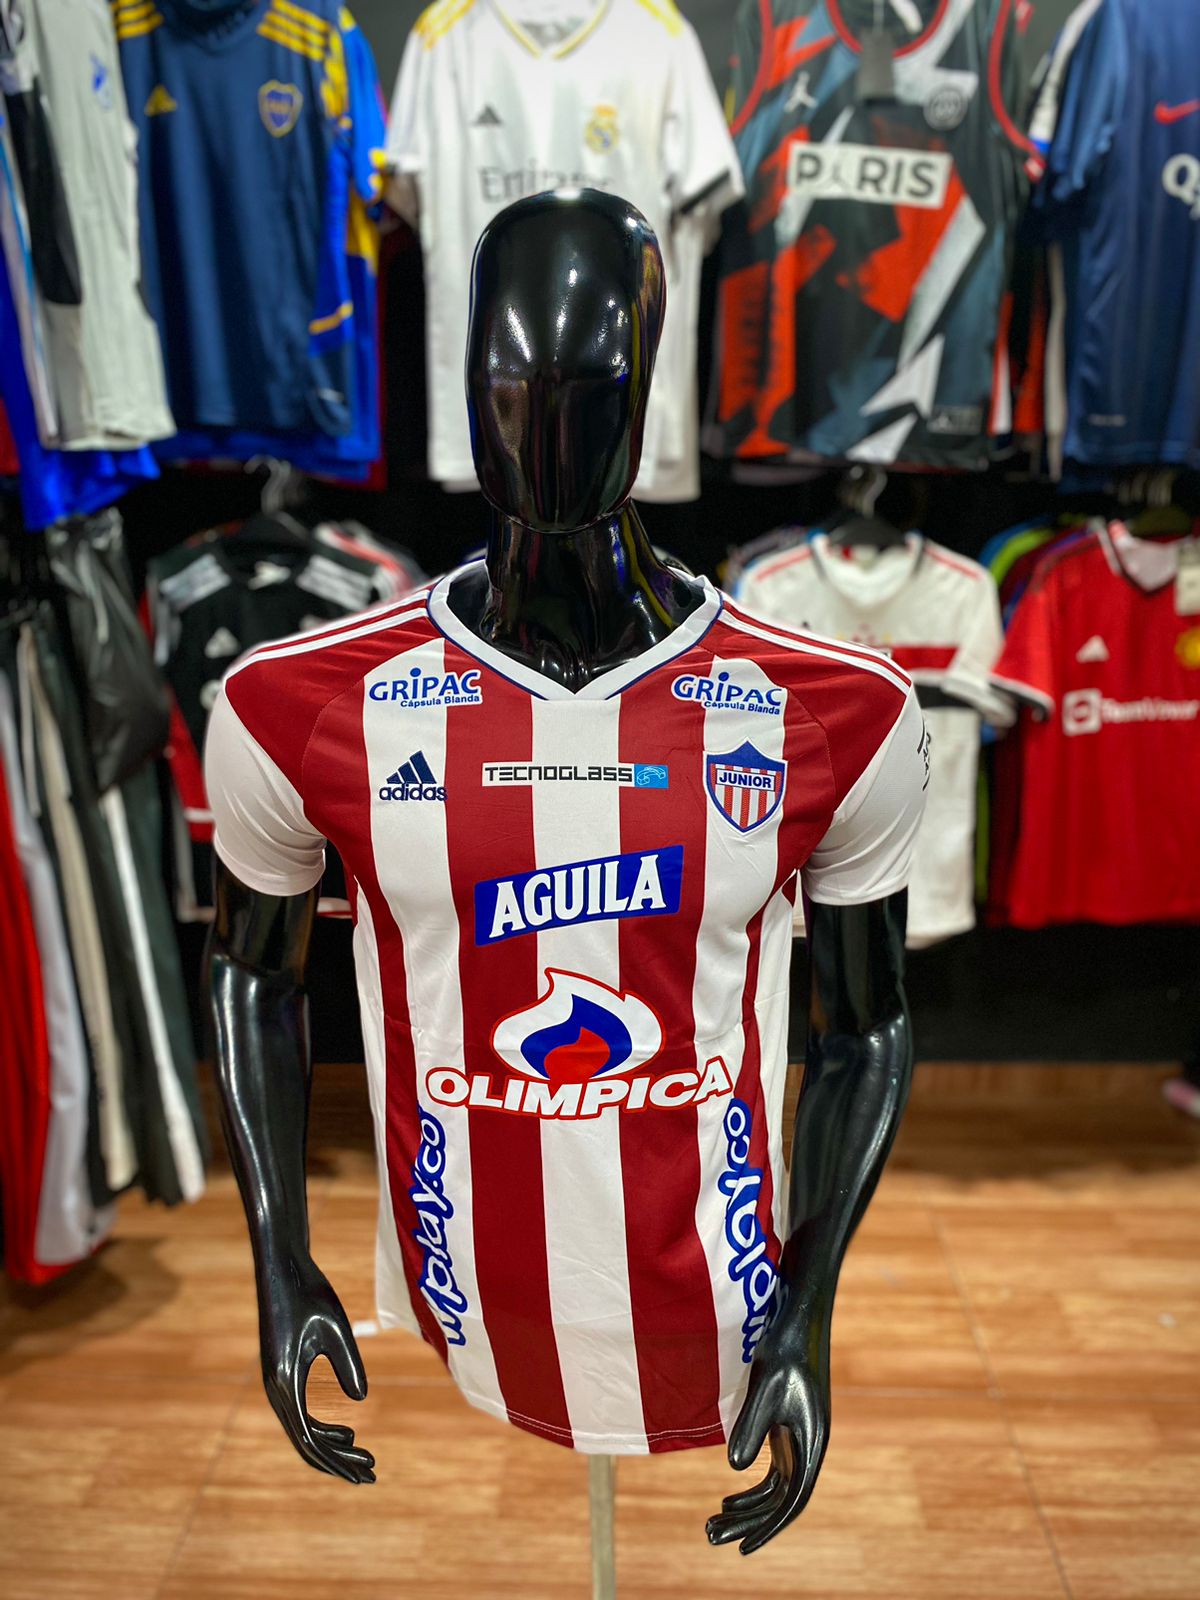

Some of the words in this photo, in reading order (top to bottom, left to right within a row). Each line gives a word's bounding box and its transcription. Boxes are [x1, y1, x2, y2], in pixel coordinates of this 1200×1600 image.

[796, 153, 935, 198] PARIS
[1162, 153, 1200, 220] Q
[444, 695, 480, 704] Blanda
[748, 703, 780, 715] Blanda
[379, 783, 448, 801] adidas
[719, 772, 772, 788] JUNIOR
[489, 854, 667, 938] AGUILA
[426, 1056, 734, 1119] OLIMPICA
